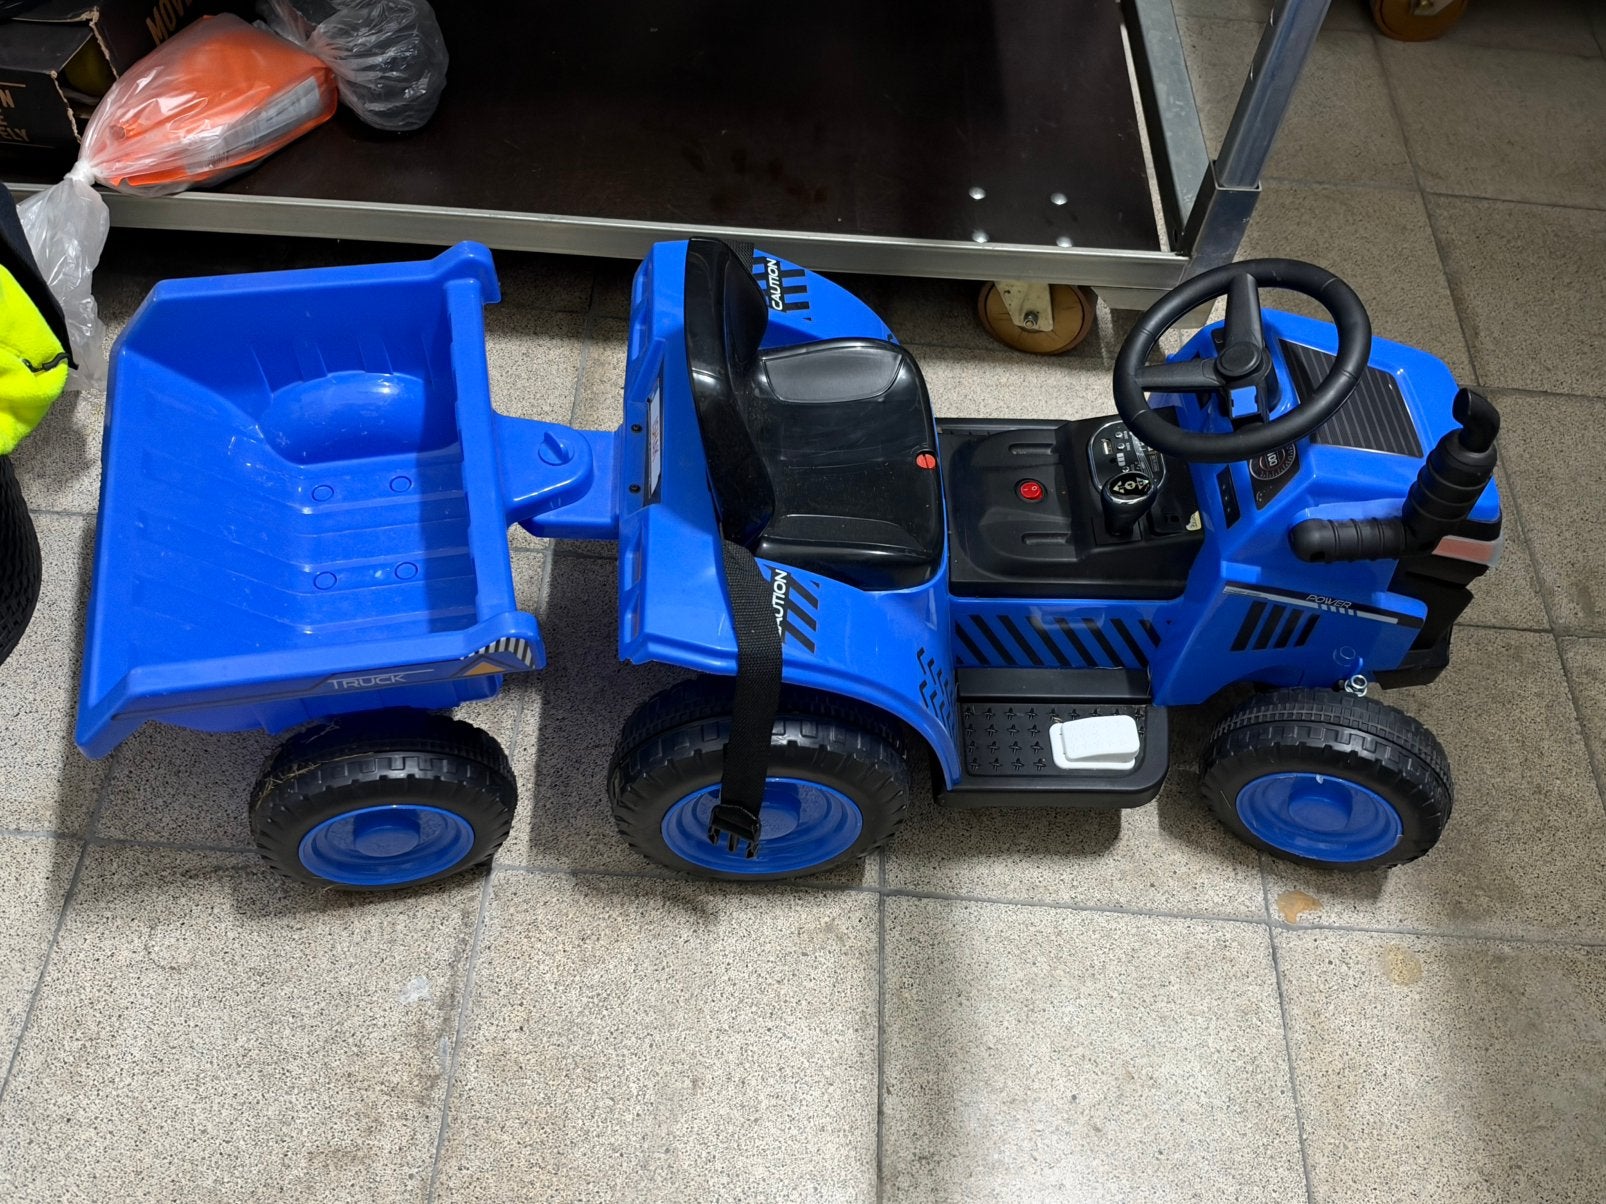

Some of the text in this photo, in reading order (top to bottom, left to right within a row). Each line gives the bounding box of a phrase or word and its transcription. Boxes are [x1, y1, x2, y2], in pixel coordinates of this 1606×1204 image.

[145, 0, 192, 47] MOV
[766, 257, 783, 311] CAUTION
[772, 569, 787, 638] AUTION
[1305, 594, 1352, 608] POWER
[327, 673, 406, 689] TRUCK
